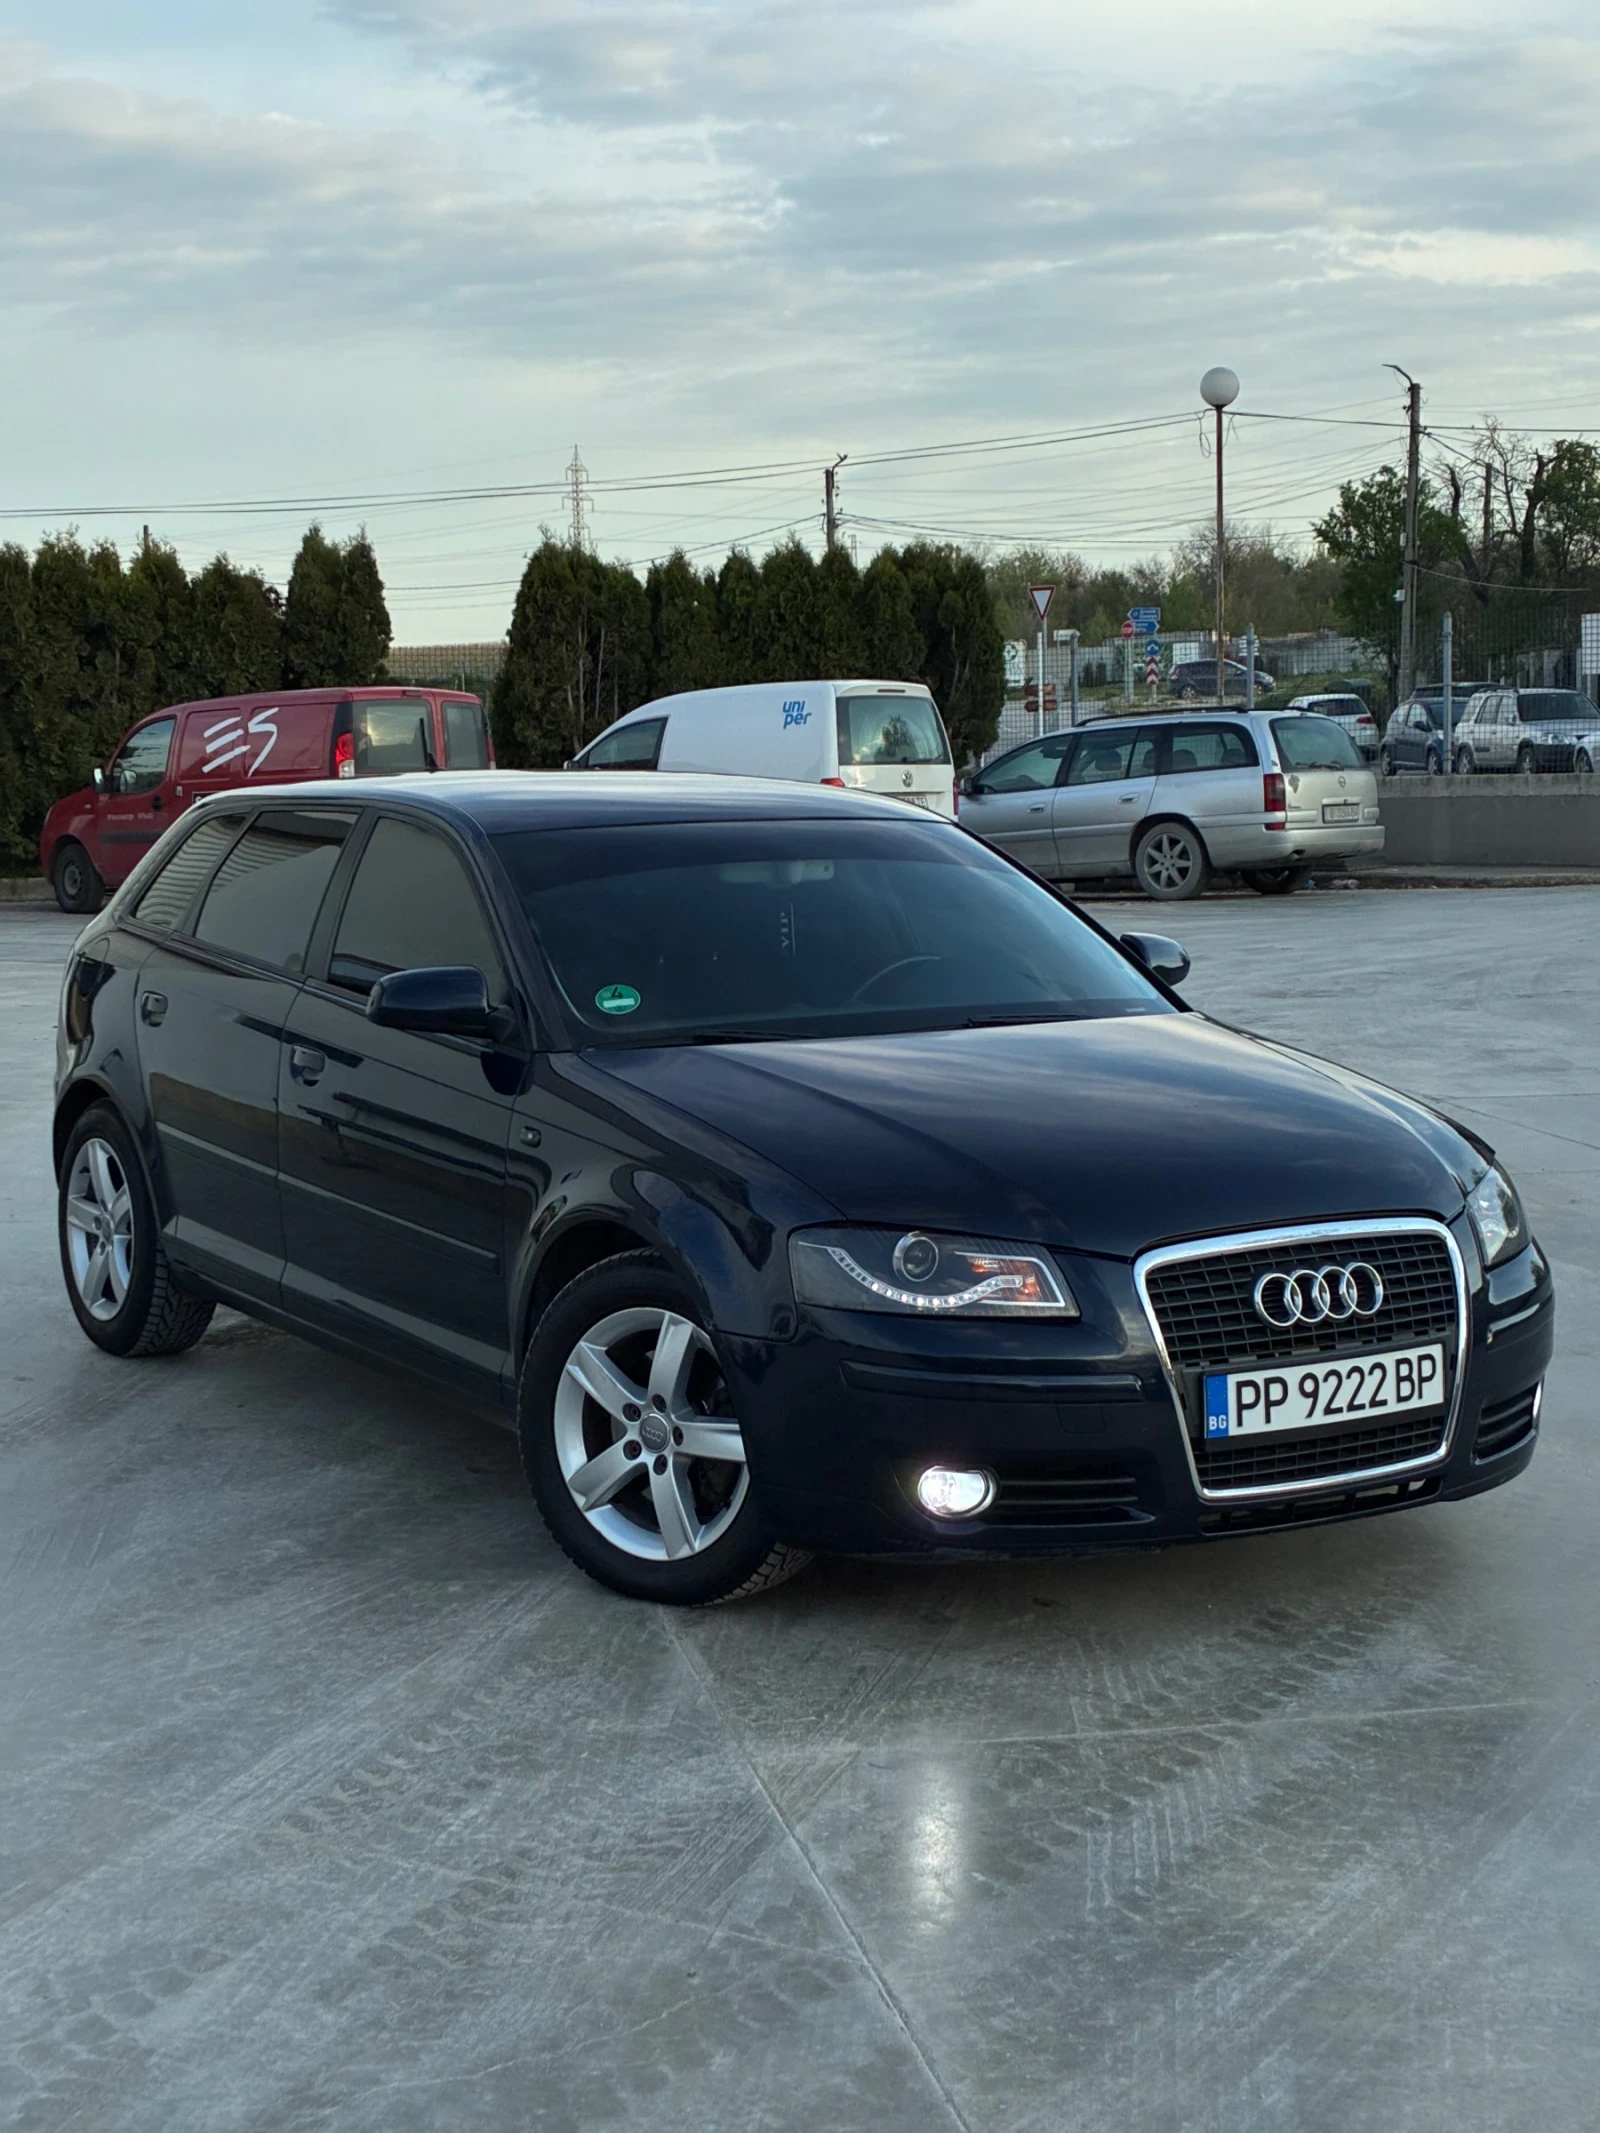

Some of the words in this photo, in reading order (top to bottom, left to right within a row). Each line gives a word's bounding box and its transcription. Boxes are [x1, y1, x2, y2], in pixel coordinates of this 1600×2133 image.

[782, 700, 806, 713] uni
[783, 712, 812, 730] per
[611, 986, 624, 998] 4
[1235, 1376, 1289, 1428] PP
[1298, 1361, 1388, 1419] 9222
[1395, 1353, 1437, 1404] BP
[1208, 1415, 1227, 1431] BG
